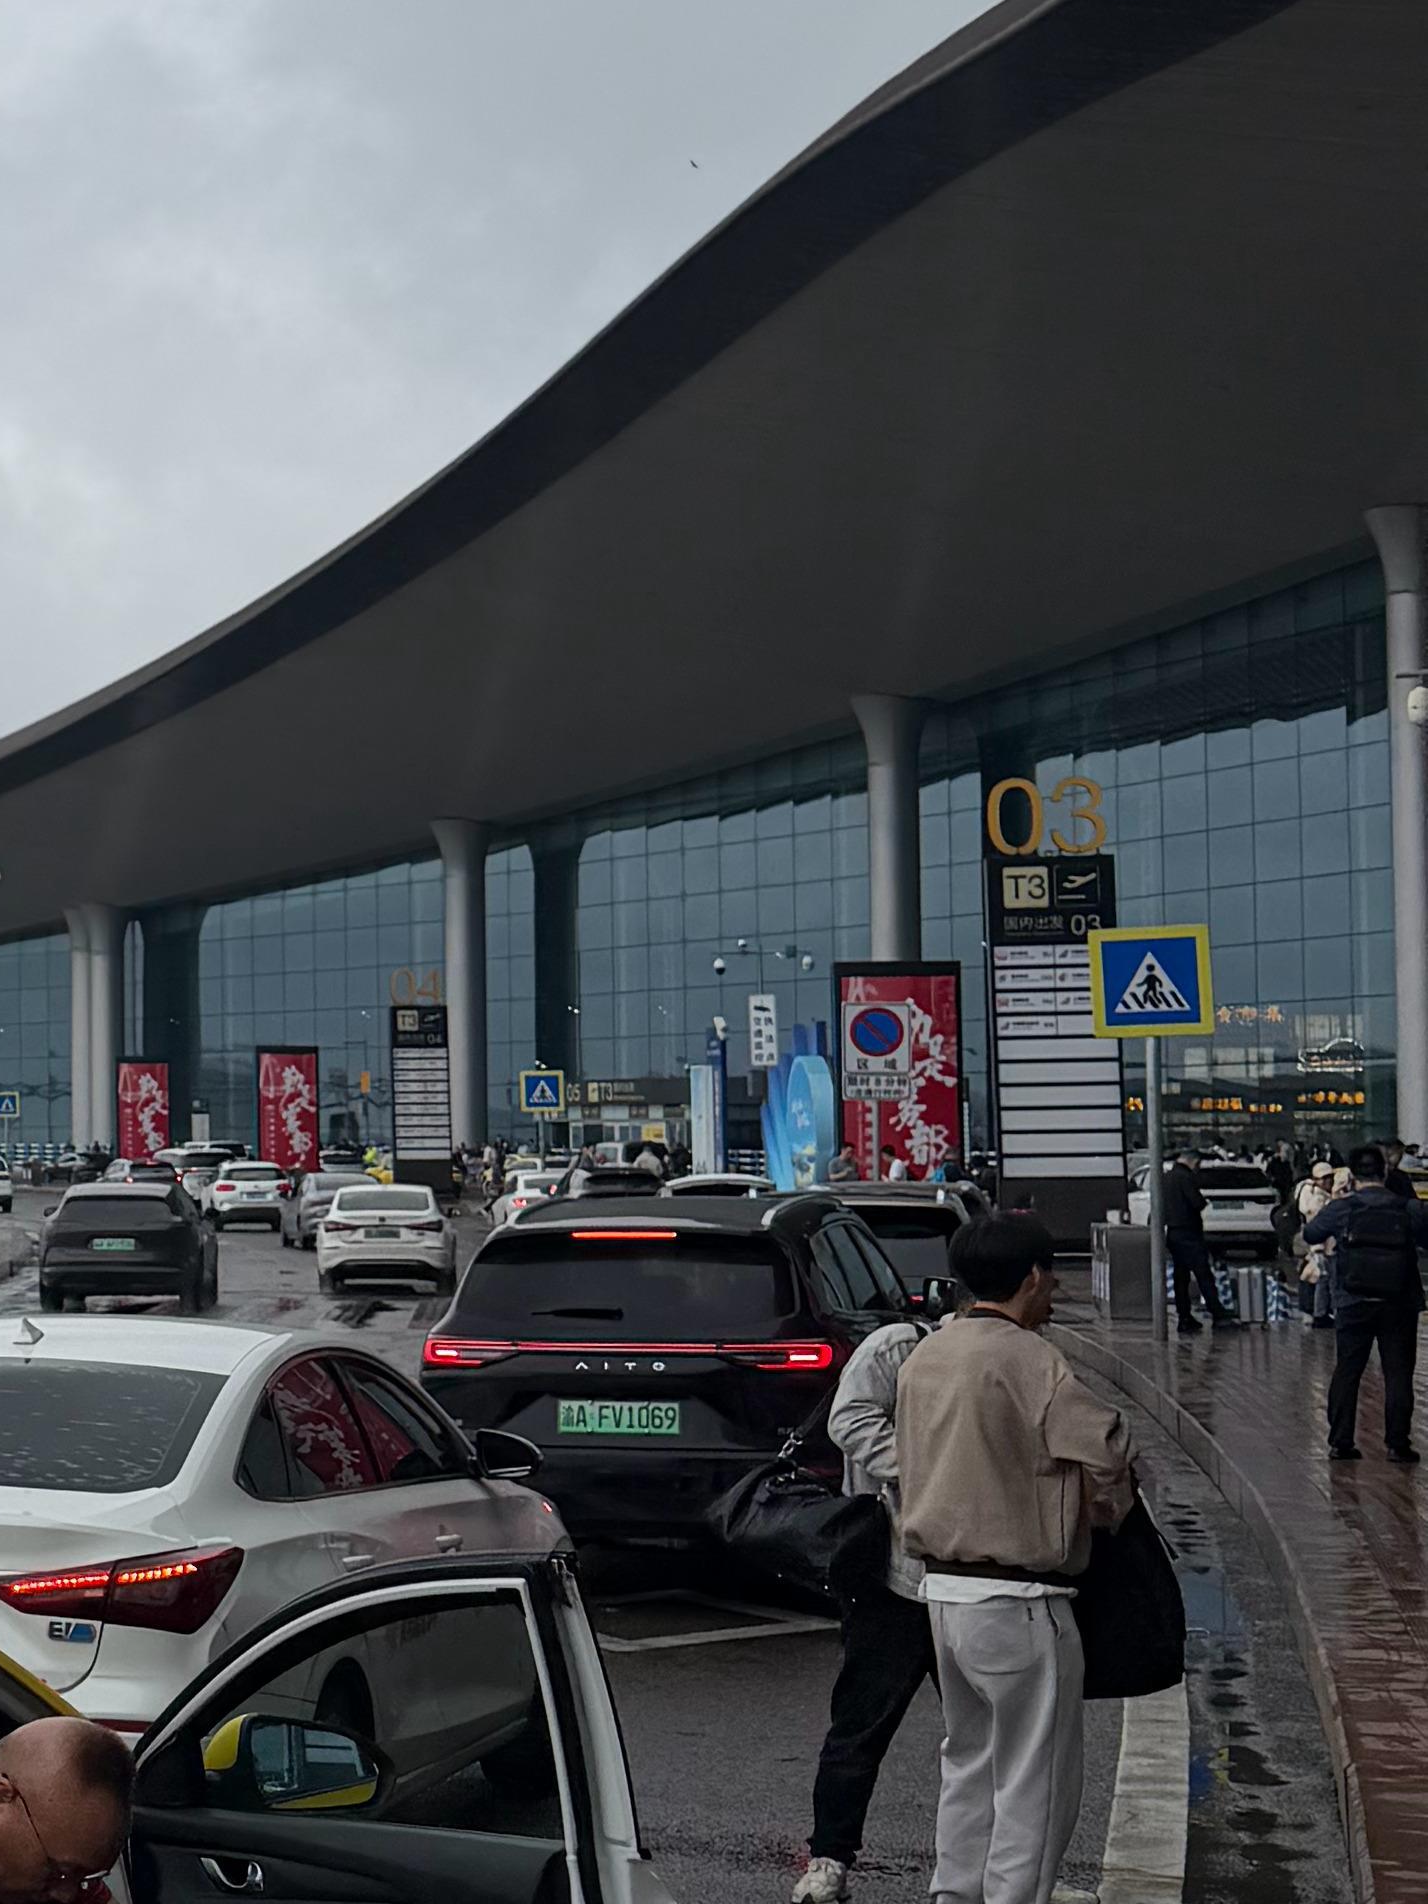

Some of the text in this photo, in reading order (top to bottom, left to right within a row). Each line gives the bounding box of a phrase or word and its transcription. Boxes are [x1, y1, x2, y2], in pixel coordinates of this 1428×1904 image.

[987, 777, 1107, 856] 03
[1004, 874, 1046, 900] T3
[575, 1361, 666, 1371] AITO
